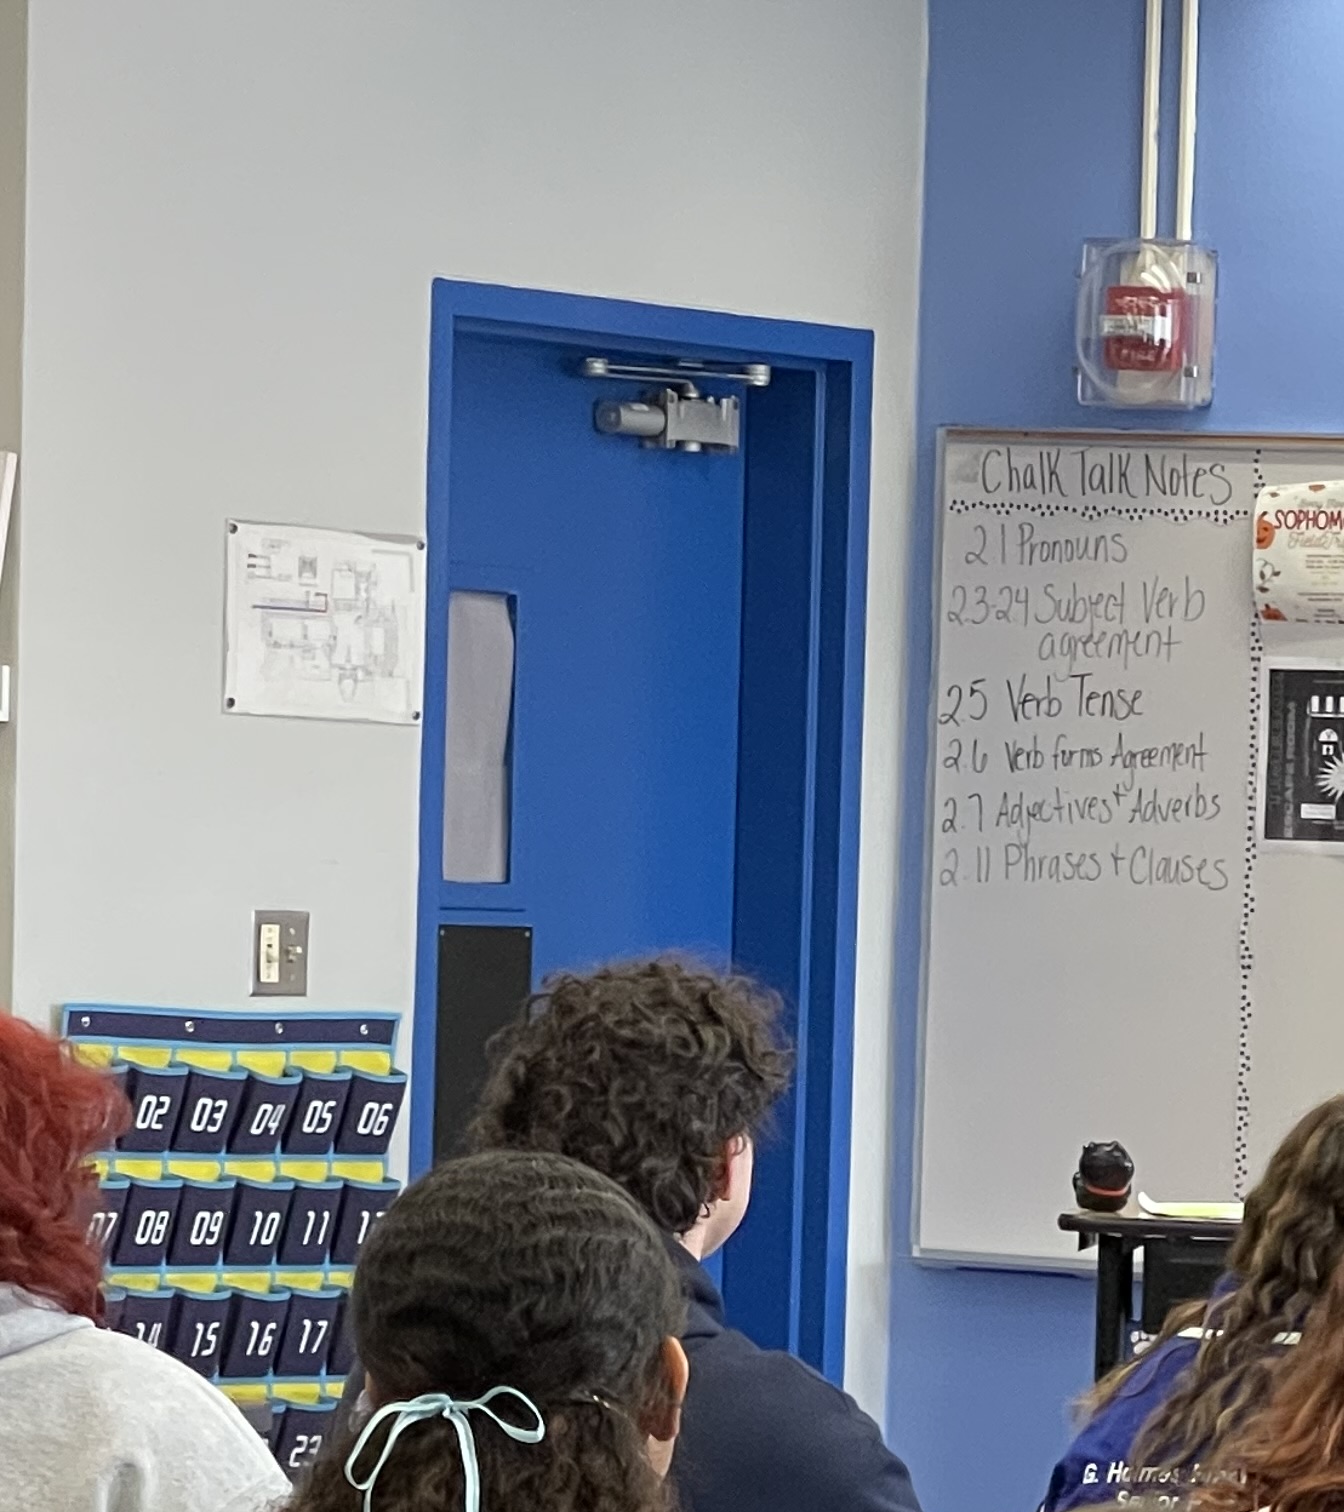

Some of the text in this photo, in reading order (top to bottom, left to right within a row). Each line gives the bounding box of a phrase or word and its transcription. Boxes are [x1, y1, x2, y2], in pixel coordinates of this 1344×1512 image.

[981, 447, 1232, 505] Chalk Talk Notes
[1017, 522, 1128, 566] Pronouns
[1034, 581, 1125, 632] Subject
[1142, 575, 1206, 624] Verb
[1038, 625, 1184, 674] agreement
[1006, 673, 1063, 722] Verb
[1069, 673, 1144, 721] Tense
[1004, 735, 1045, 774] Verb
[1109, 731, 1208, 784] Agreement
[995, 786, 1113, 836] Adjectives
[1128, 782, 1221, 825] Adverbs
[1004, 843, 1102, 883] Phrases
[1130, 845, 1229, 890] Clauses
[136, 1095, 171, 1129] 02
[190, 1098, 228, 1132] 03
[250, 1103, 287, 1135] 04
[302, 1100, 337, 1134] 05
[357, 1101, 393, 1136] 06
[135, 1210, 170, 1245] 08
[190, 1211, 224, 1245] 09
[249, 1211, 281, 1245] 10
[303, 1210, 330, 1245] 11
[191, 1322, 220, 1357] 15
[246, 1321, 277, 1356] 16
[299, 1319, 328, 1354] 17
